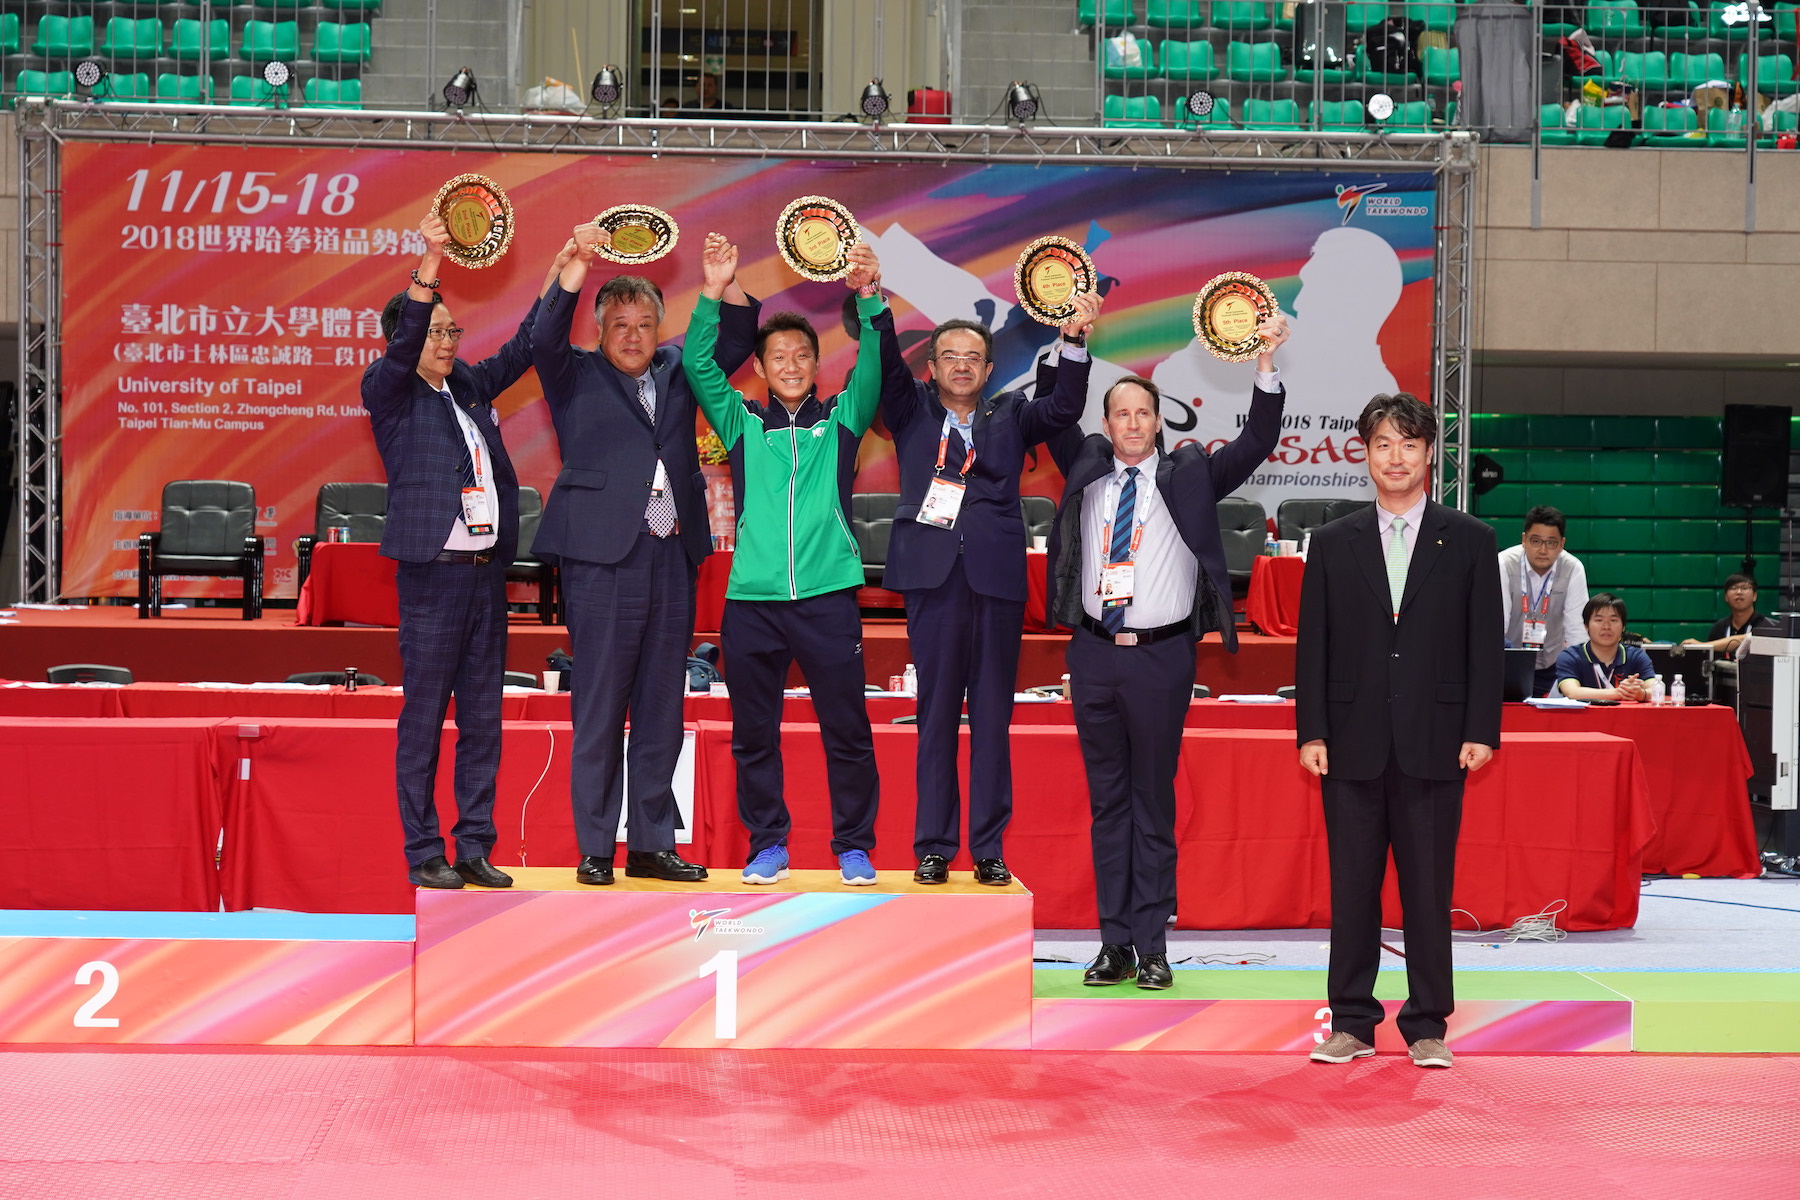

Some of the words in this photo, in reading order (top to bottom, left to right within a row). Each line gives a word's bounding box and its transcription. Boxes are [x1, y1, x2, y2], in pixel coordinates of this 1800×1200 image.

[126, 168, 360, 216] 11/15-18
[1367, 197, 1401, 206] WORLD
[1367, 206, 1428, 216] TAEKWONDO
[121, 303, 383, 339] 臺北市立大學體育
[113, 342, 387, 366] (臺北市士林區忠誠路二段10
[118, 376, 214, 397] University
[219, 378, 239, 394] of
[244, 378, 302, 398] Taipei
[118, 401, 138, 413] No.
[142, 402, 168, 415] 101,
[171, 402, 219, 414] Section
[222, 403, 234, 415] 2,
[237, 403, 314, 418] Zhongcheng
[317, 405, 338, 417] Rd,
[341, 406, 371, 417] Univ
[118, 417, 157, 431] Taipei
[161, 417, 211, 430] Tian-Mu
[214, 418, 264, 432] Campus
[1282, 414, 1311, 430] 018
[1245, 471, 1369, 488] hampionships
[73, 960, 120, 1028] 2
[699, 949, 738, 1039] 1
[1313, 1006, 1333, 1045] 3
